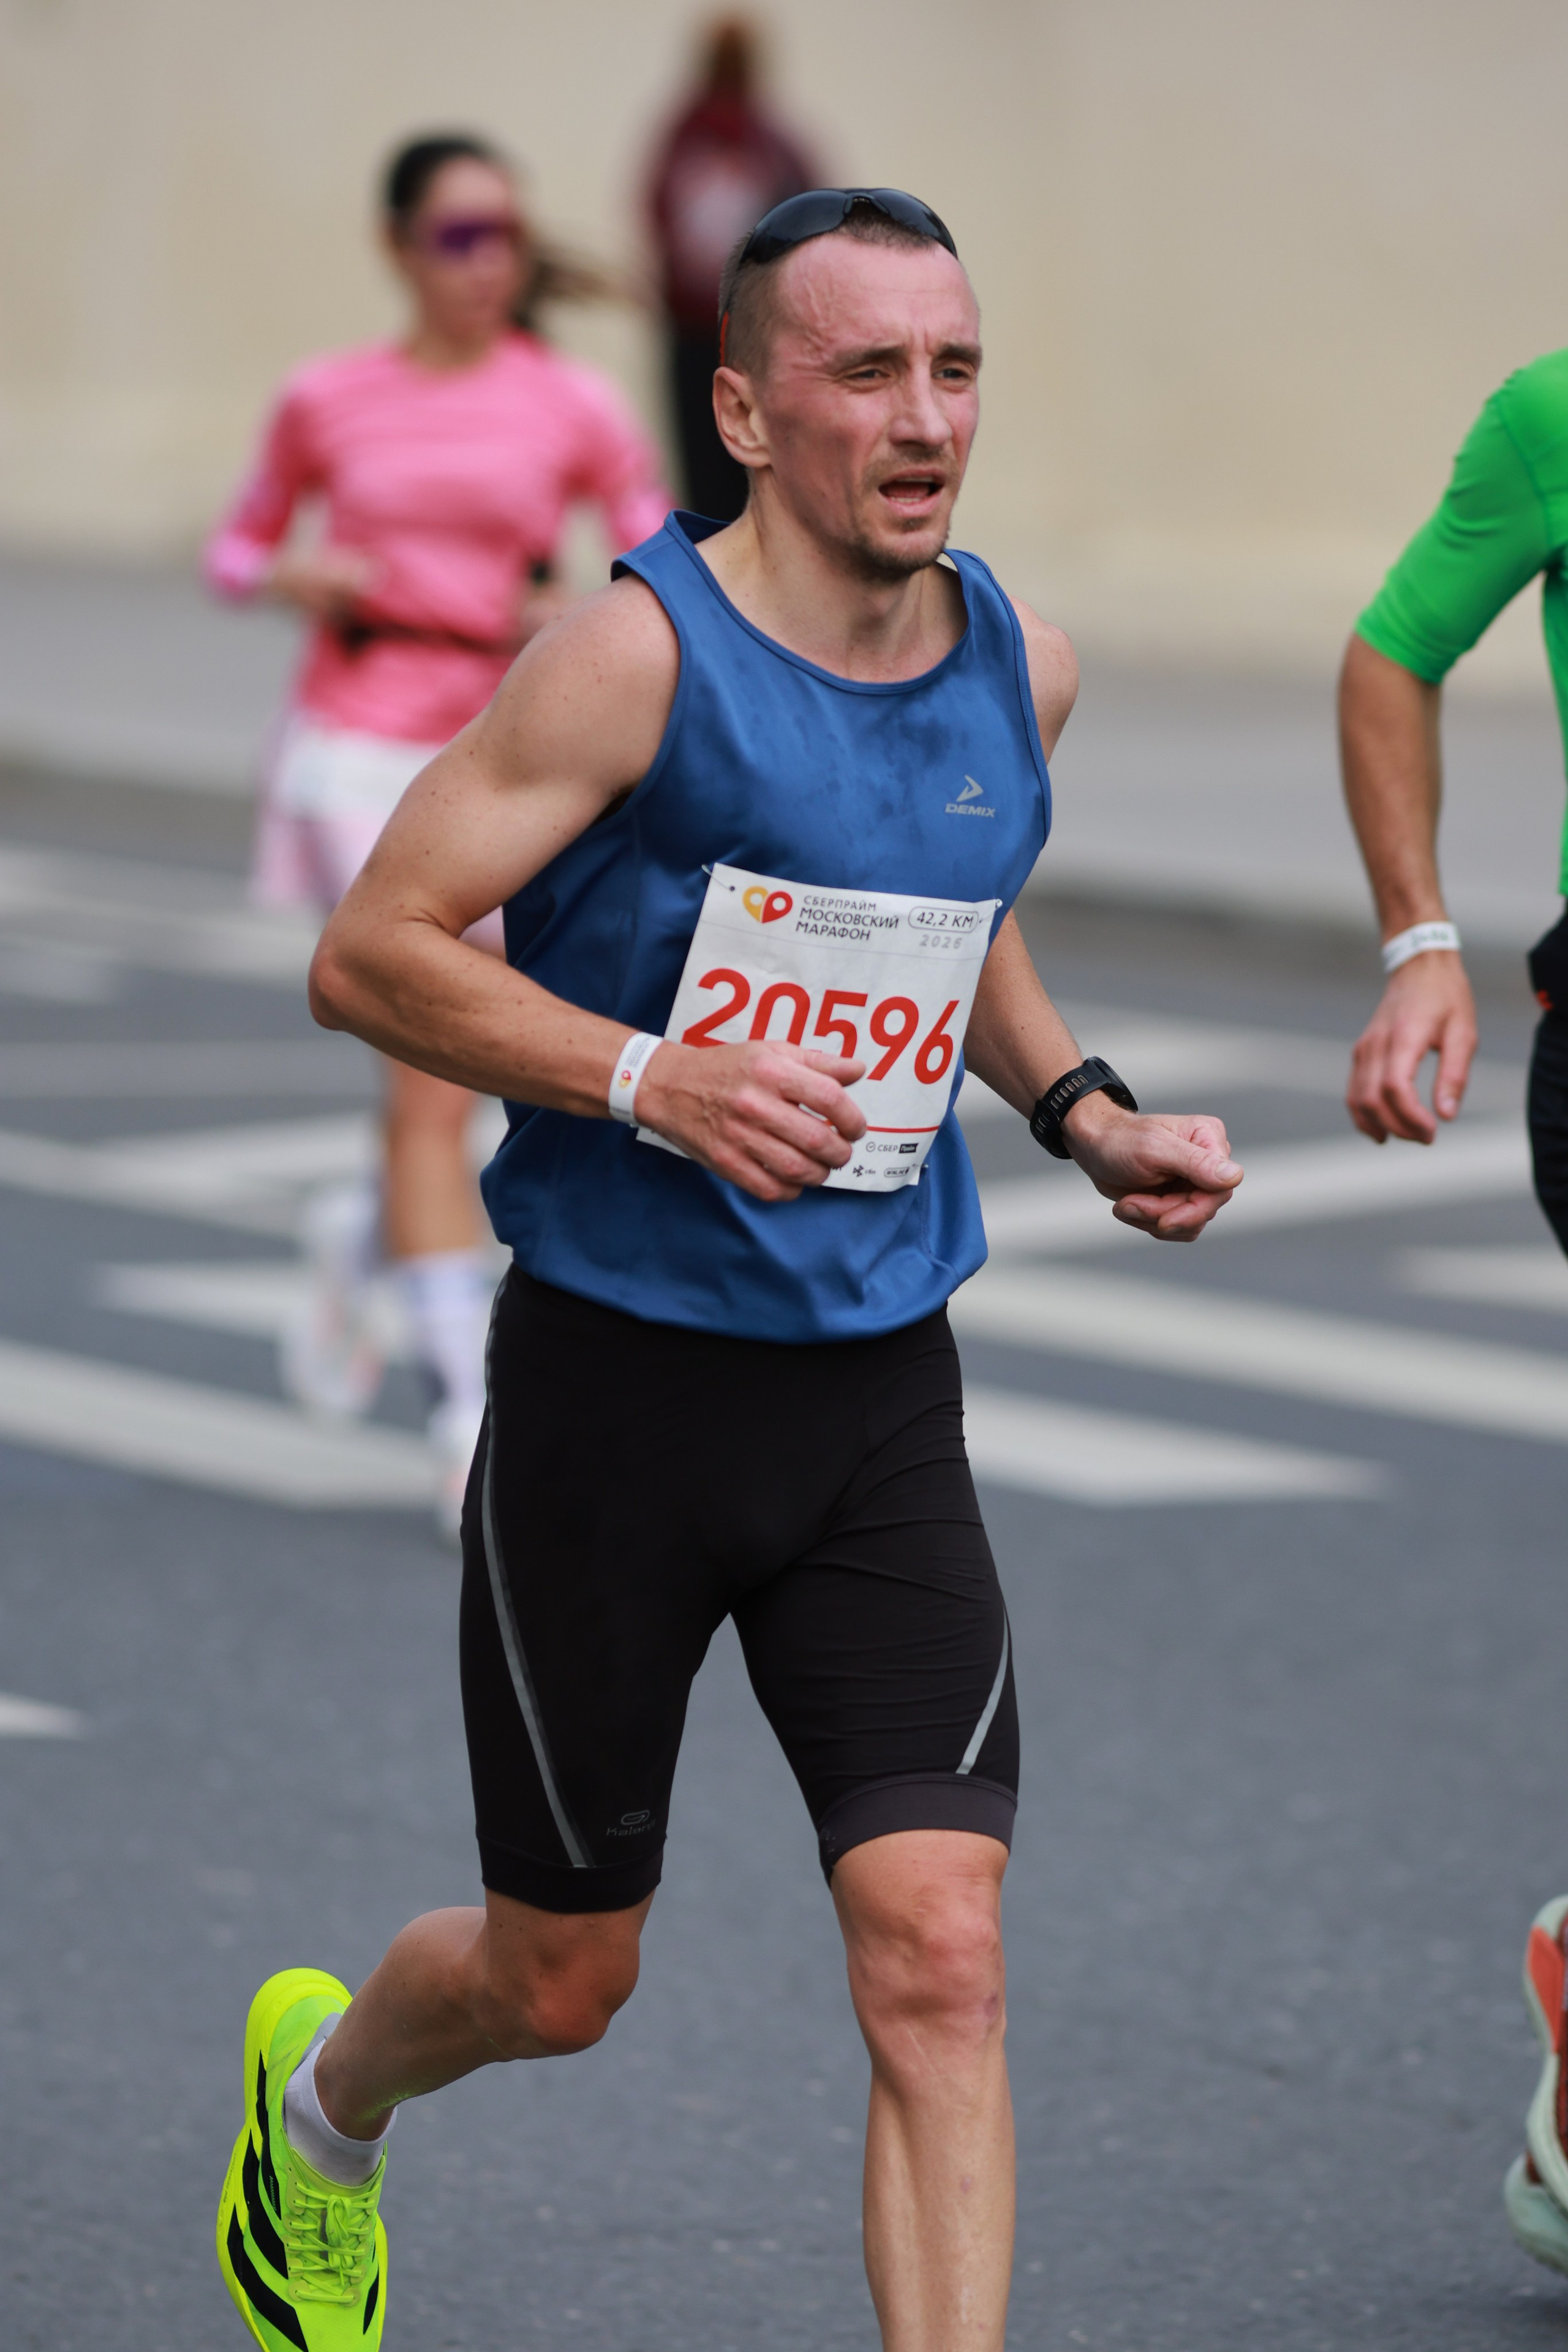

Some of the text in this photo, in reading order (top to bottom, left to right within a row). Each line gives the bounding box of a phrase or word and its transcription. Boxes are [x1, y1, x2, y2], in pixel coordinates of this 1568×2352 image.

[944, 803, 995, 818] DEMIX
[804, 895, 876, 911] СБЕРПРАЙМ
[799, 907, 899, 929] МОСКОВСКИЙ
[917, 911, 948, 927] 42,2
[796, 921, 871, 940] МАРАФОН
[680, 967, 960, 1085] 20596
